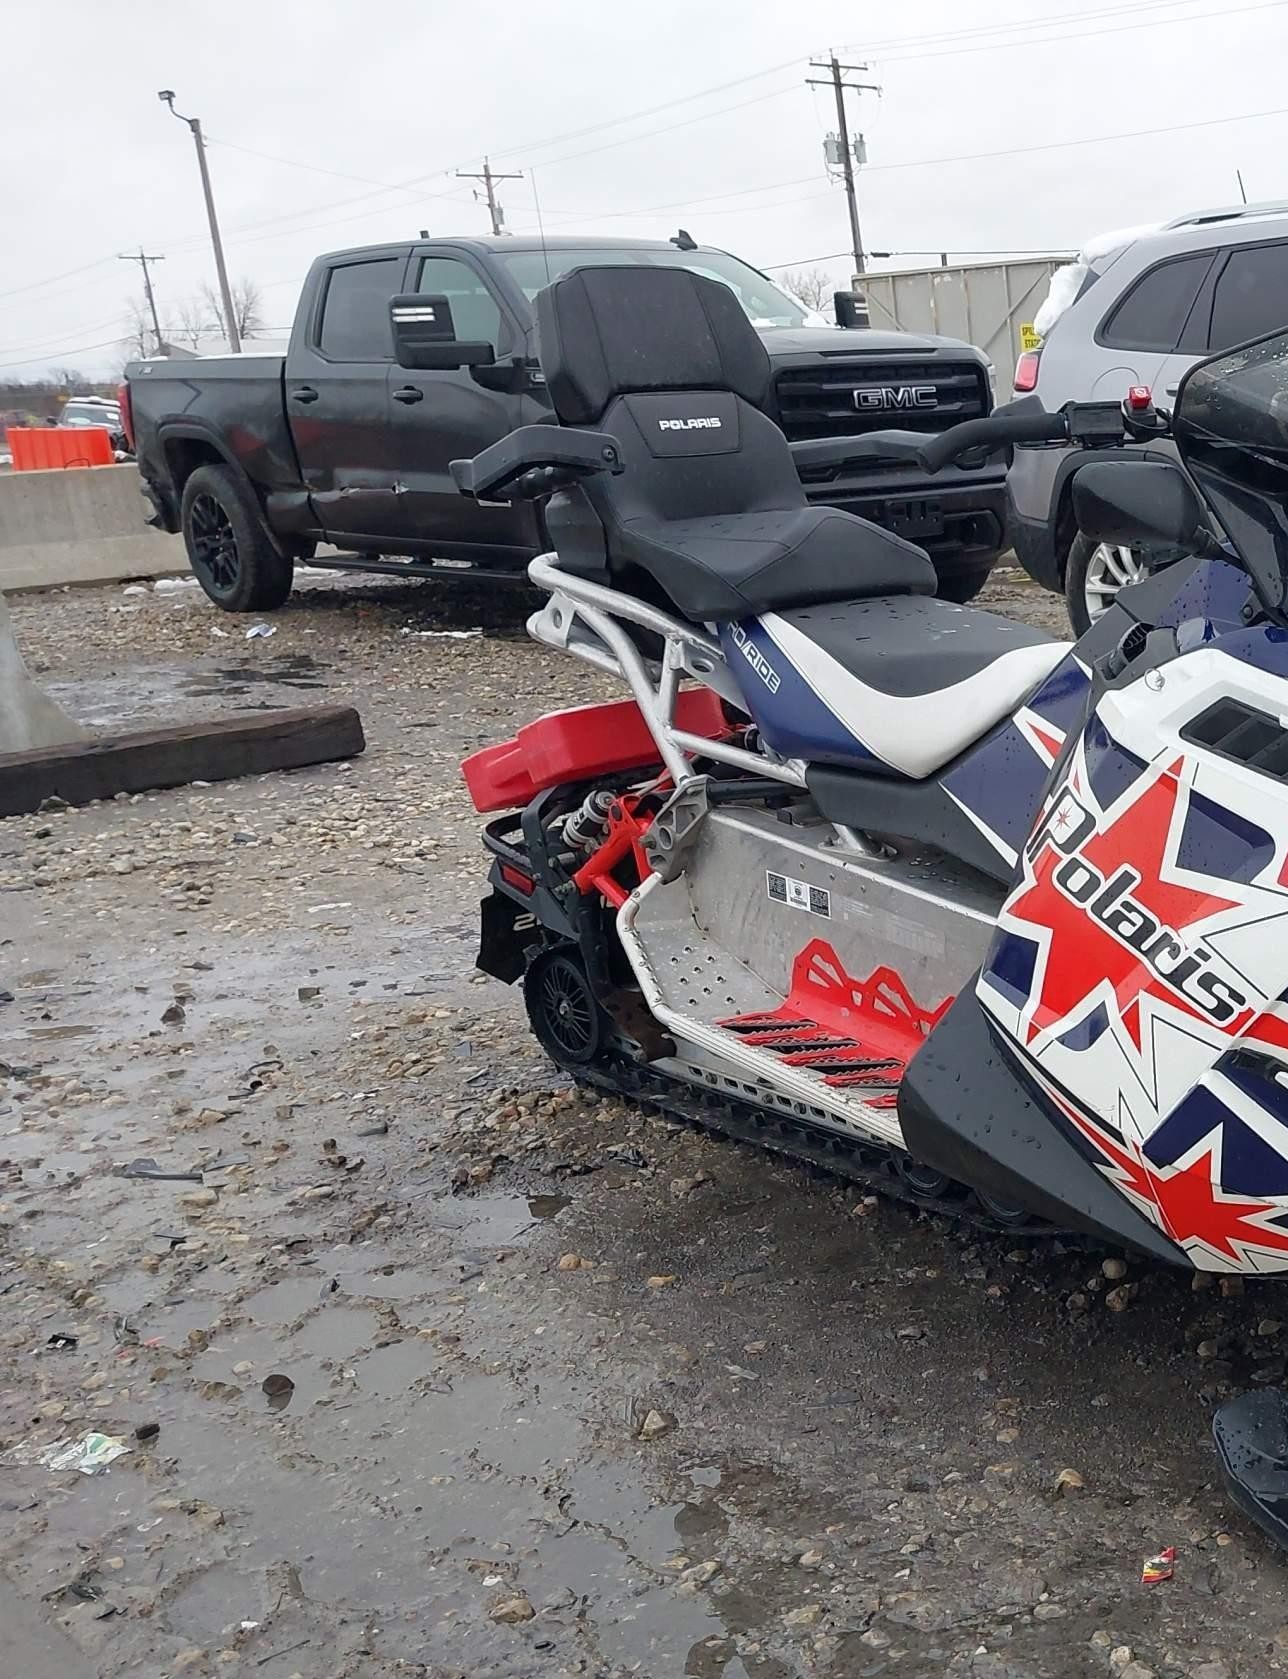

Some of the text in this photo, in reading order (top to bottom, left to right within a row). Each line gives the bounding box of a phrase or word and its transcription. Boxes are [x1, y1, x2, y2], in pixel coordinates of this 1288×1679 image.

[853, 386, 938, 409] GMC
[658, 417, 722, 431] POLARIS
[1028, 790, 1247, 1021] Polaris
